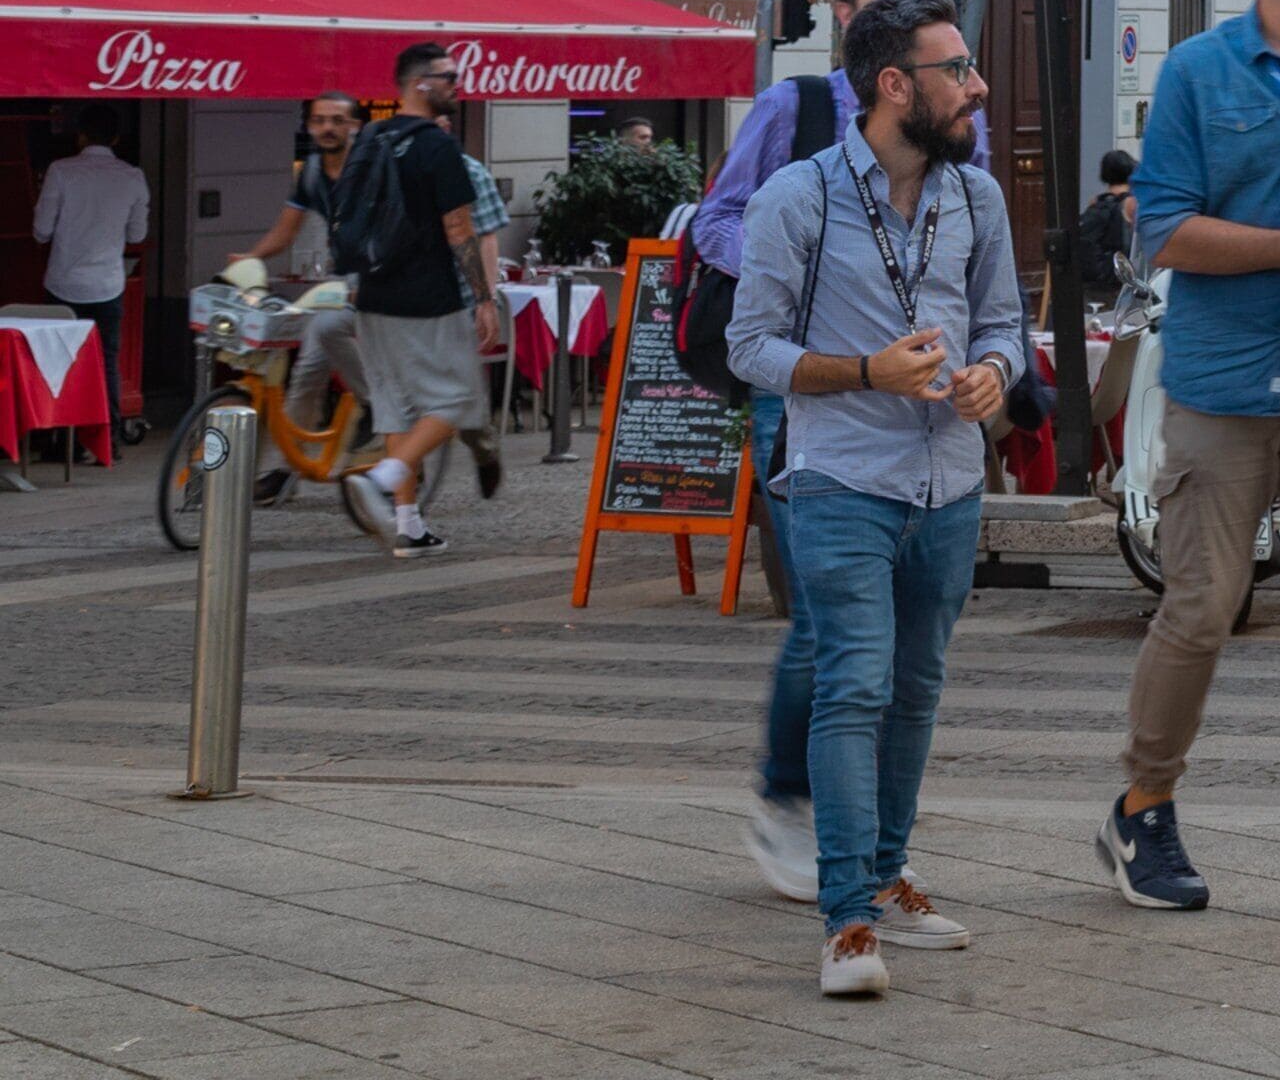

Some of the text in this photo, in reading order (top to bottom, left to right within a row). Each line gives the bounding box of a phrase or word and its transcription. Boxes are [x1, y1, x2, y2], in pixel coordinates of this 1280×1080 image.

[88, 30, 643, 94] Pizza Ristorante
[875, 226, 893, 259] SPACES
